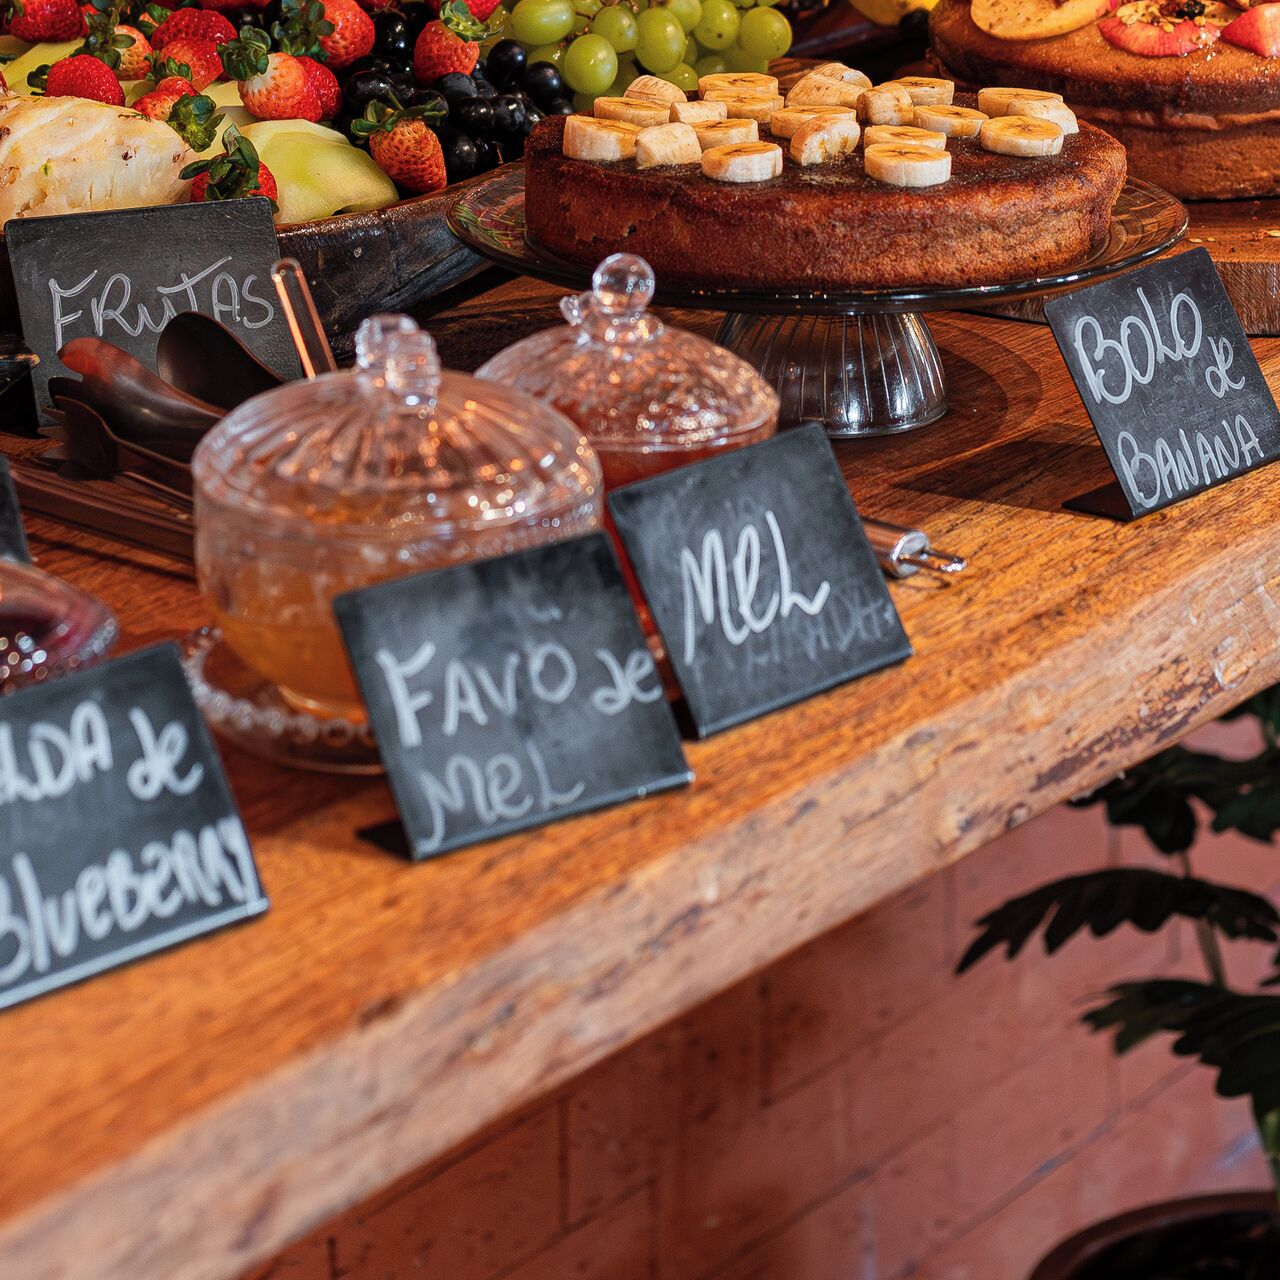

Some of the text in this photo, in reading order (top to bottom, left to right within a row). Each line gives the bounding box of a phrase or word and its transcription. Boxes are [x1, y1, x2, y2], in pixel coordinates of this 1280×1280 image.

[1073, 286, 1246, 405] BOLO de
[1117, 413, 1265, 509] BANANA
[374, 640, 664, 748] FAVO de
[126, 706, 206, 801] de
